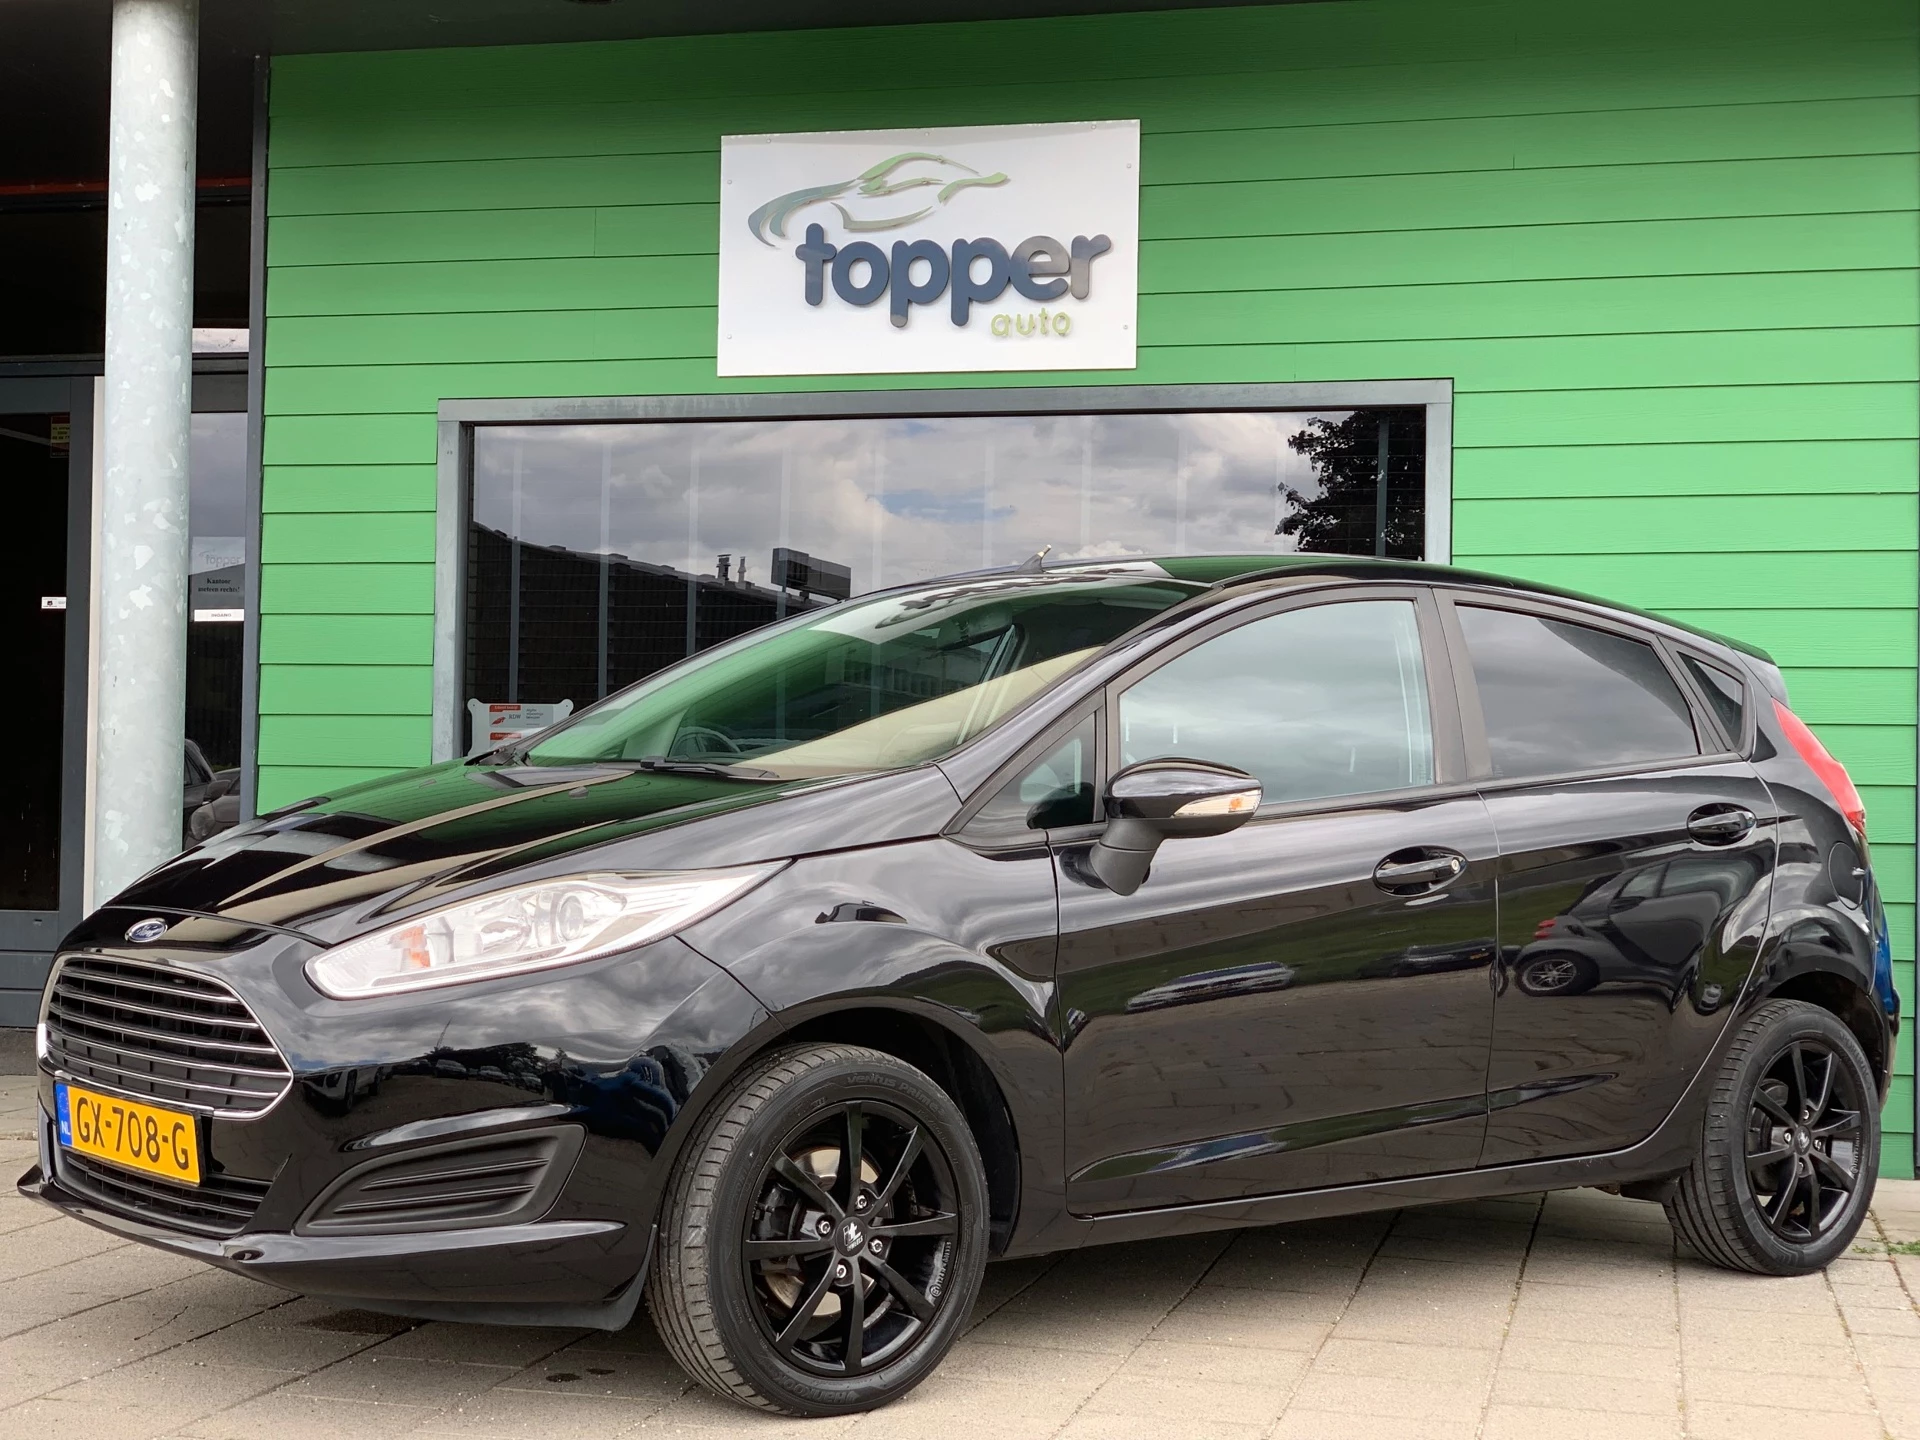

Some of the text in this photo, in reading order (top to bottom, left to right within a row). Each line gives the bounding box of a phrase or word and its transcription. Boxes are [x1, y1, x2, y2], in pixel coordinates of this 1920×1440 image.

[795, 223, 1112, 328] topper
[990, 307, 1072, 338] auto
[205, 554, 242, 568] topper
[206, 577, 232, 585] Kantoor
[61, 1120, 71, 1136] NL
[75, 1096, 190, 1172] GX-708-G
